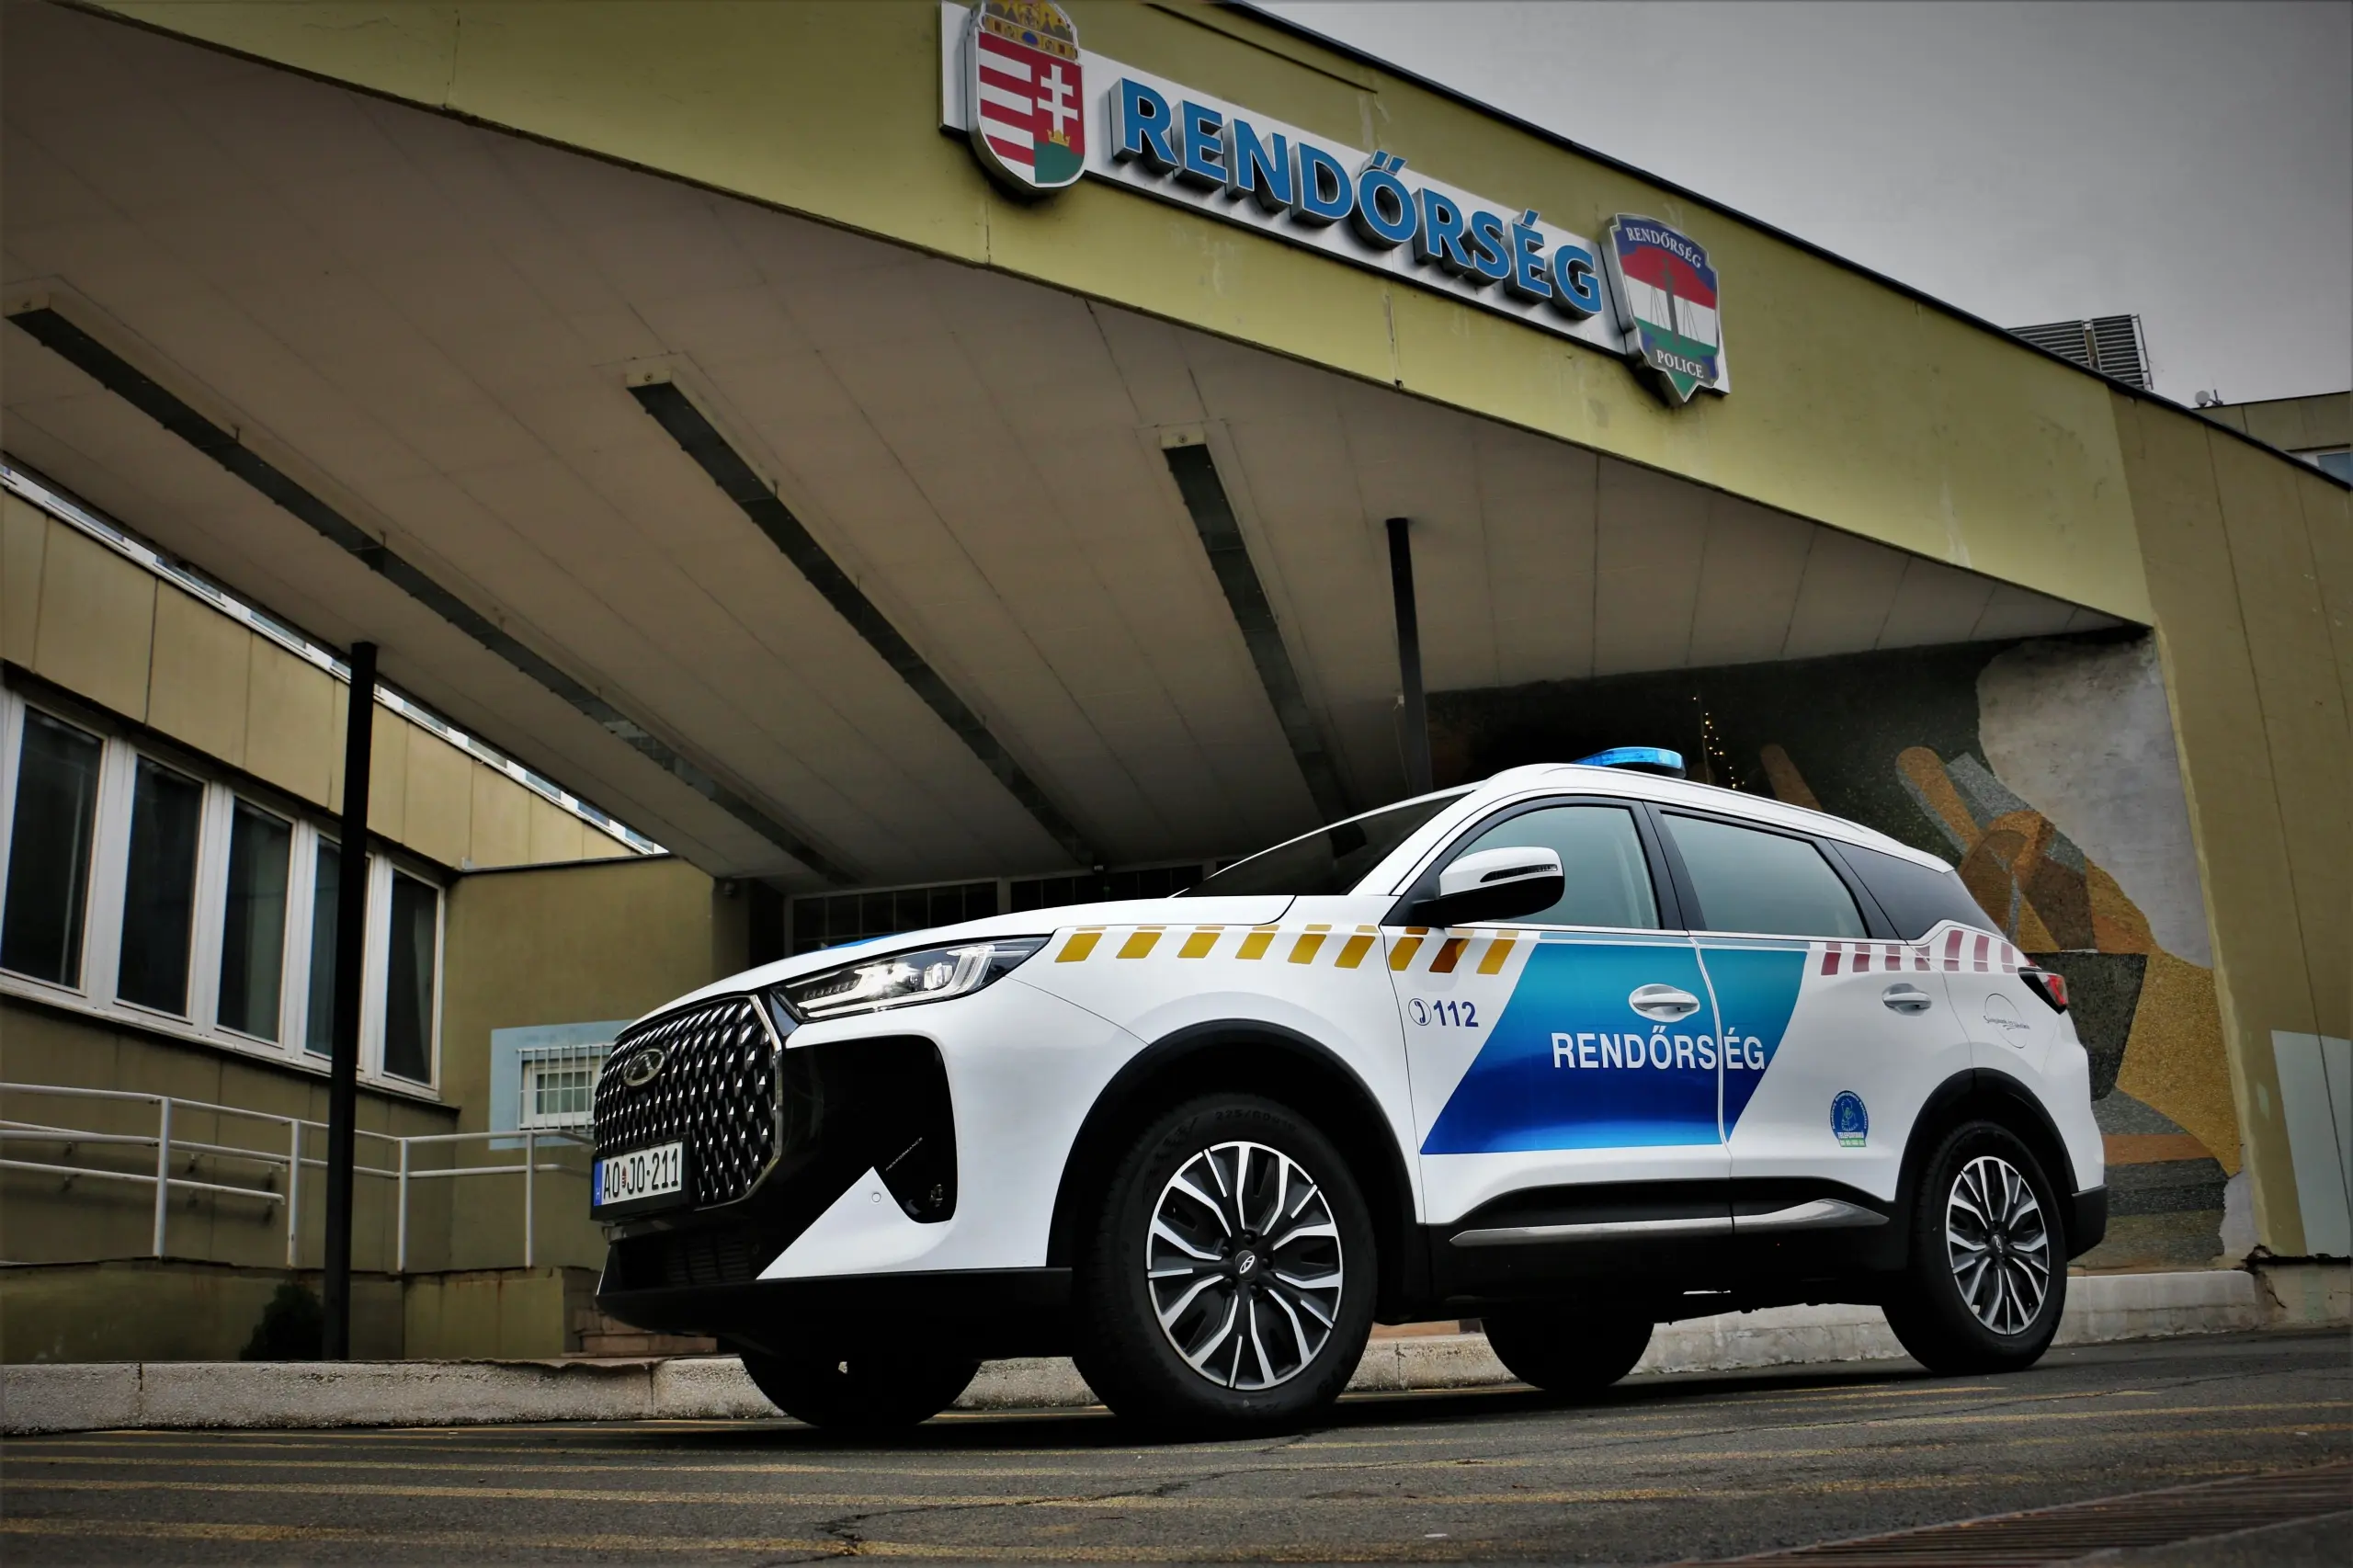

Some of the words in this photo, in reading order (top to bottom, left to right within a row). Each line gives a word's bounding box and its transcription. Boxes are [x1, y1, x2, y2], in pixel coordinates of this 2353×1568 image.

[1113, 76, 1603, 318] RENDŐRSÉG
[1625, 227, 1701, 268] RENDŐRSÉG
[1655, 349, 1704, 379] POLICE
[1433, 1000, 1479, 1028] 112
[1551, 1025, 1766, 1070] RENDŐRSÉG
